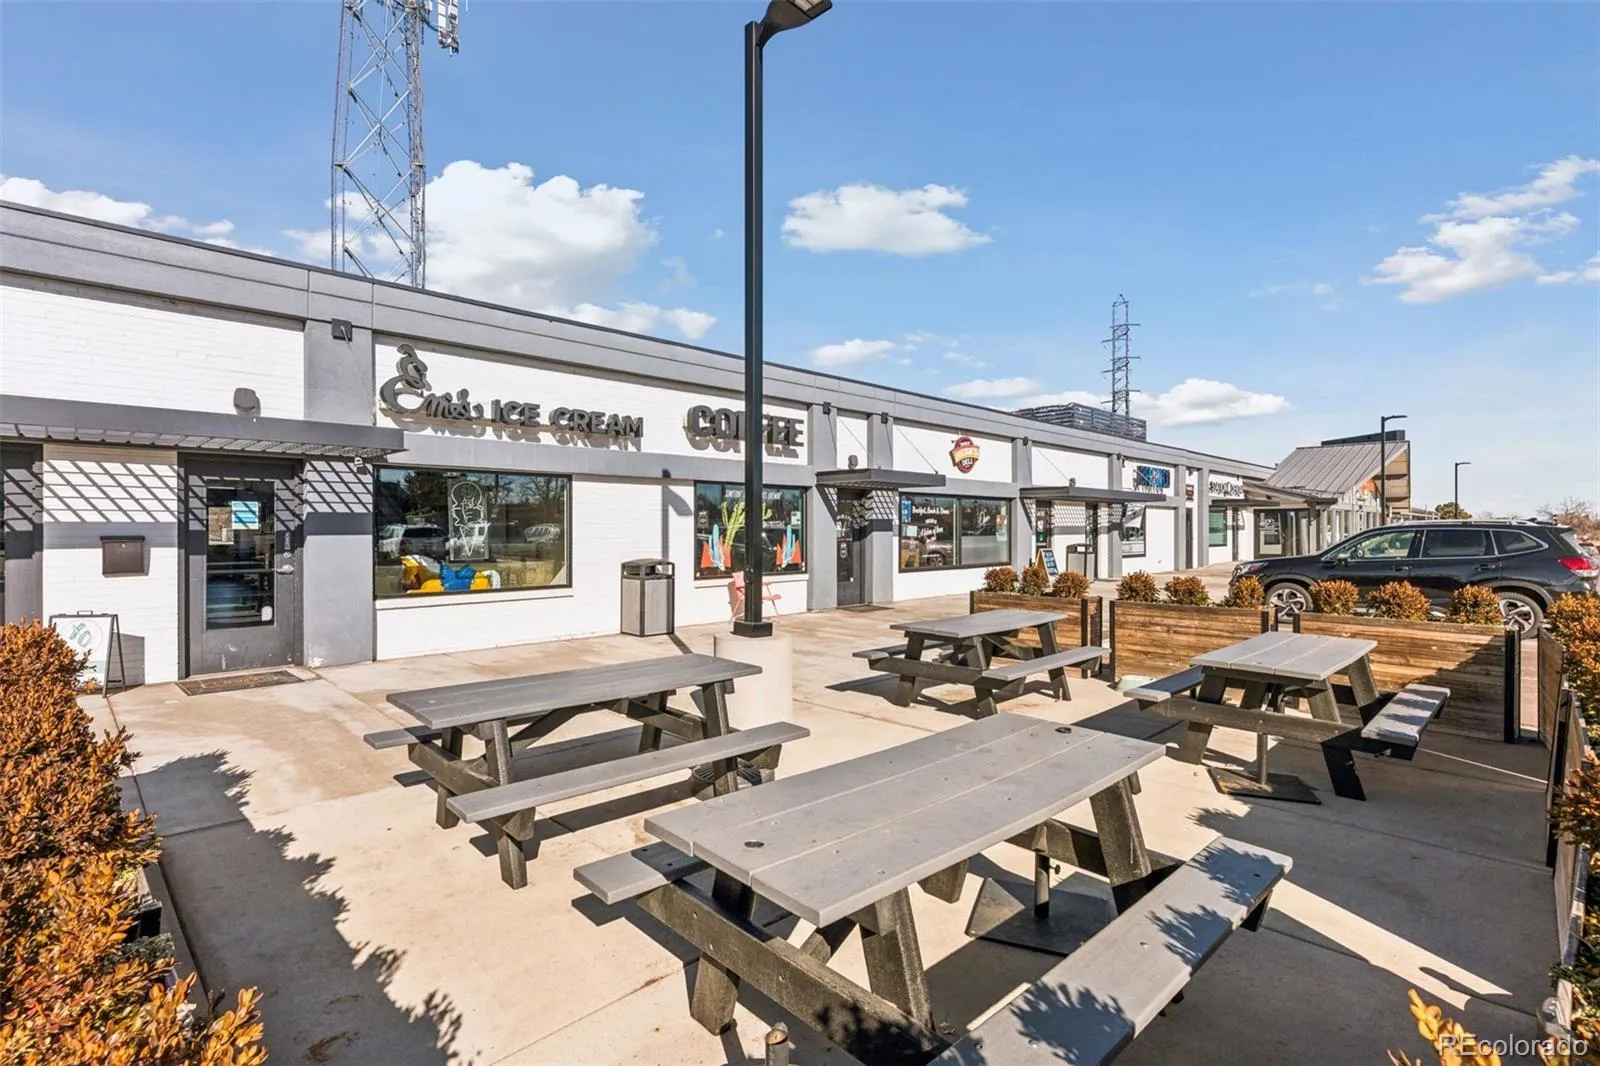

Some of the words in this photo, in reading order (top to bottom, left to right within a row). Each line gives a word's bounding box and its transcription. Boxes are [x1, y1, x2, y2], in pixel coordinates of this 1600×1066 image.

[491, 399, 541, 427] ICE
[549, 407, 644, 438] CREAM
[687, 405, 804, 446] COEE
